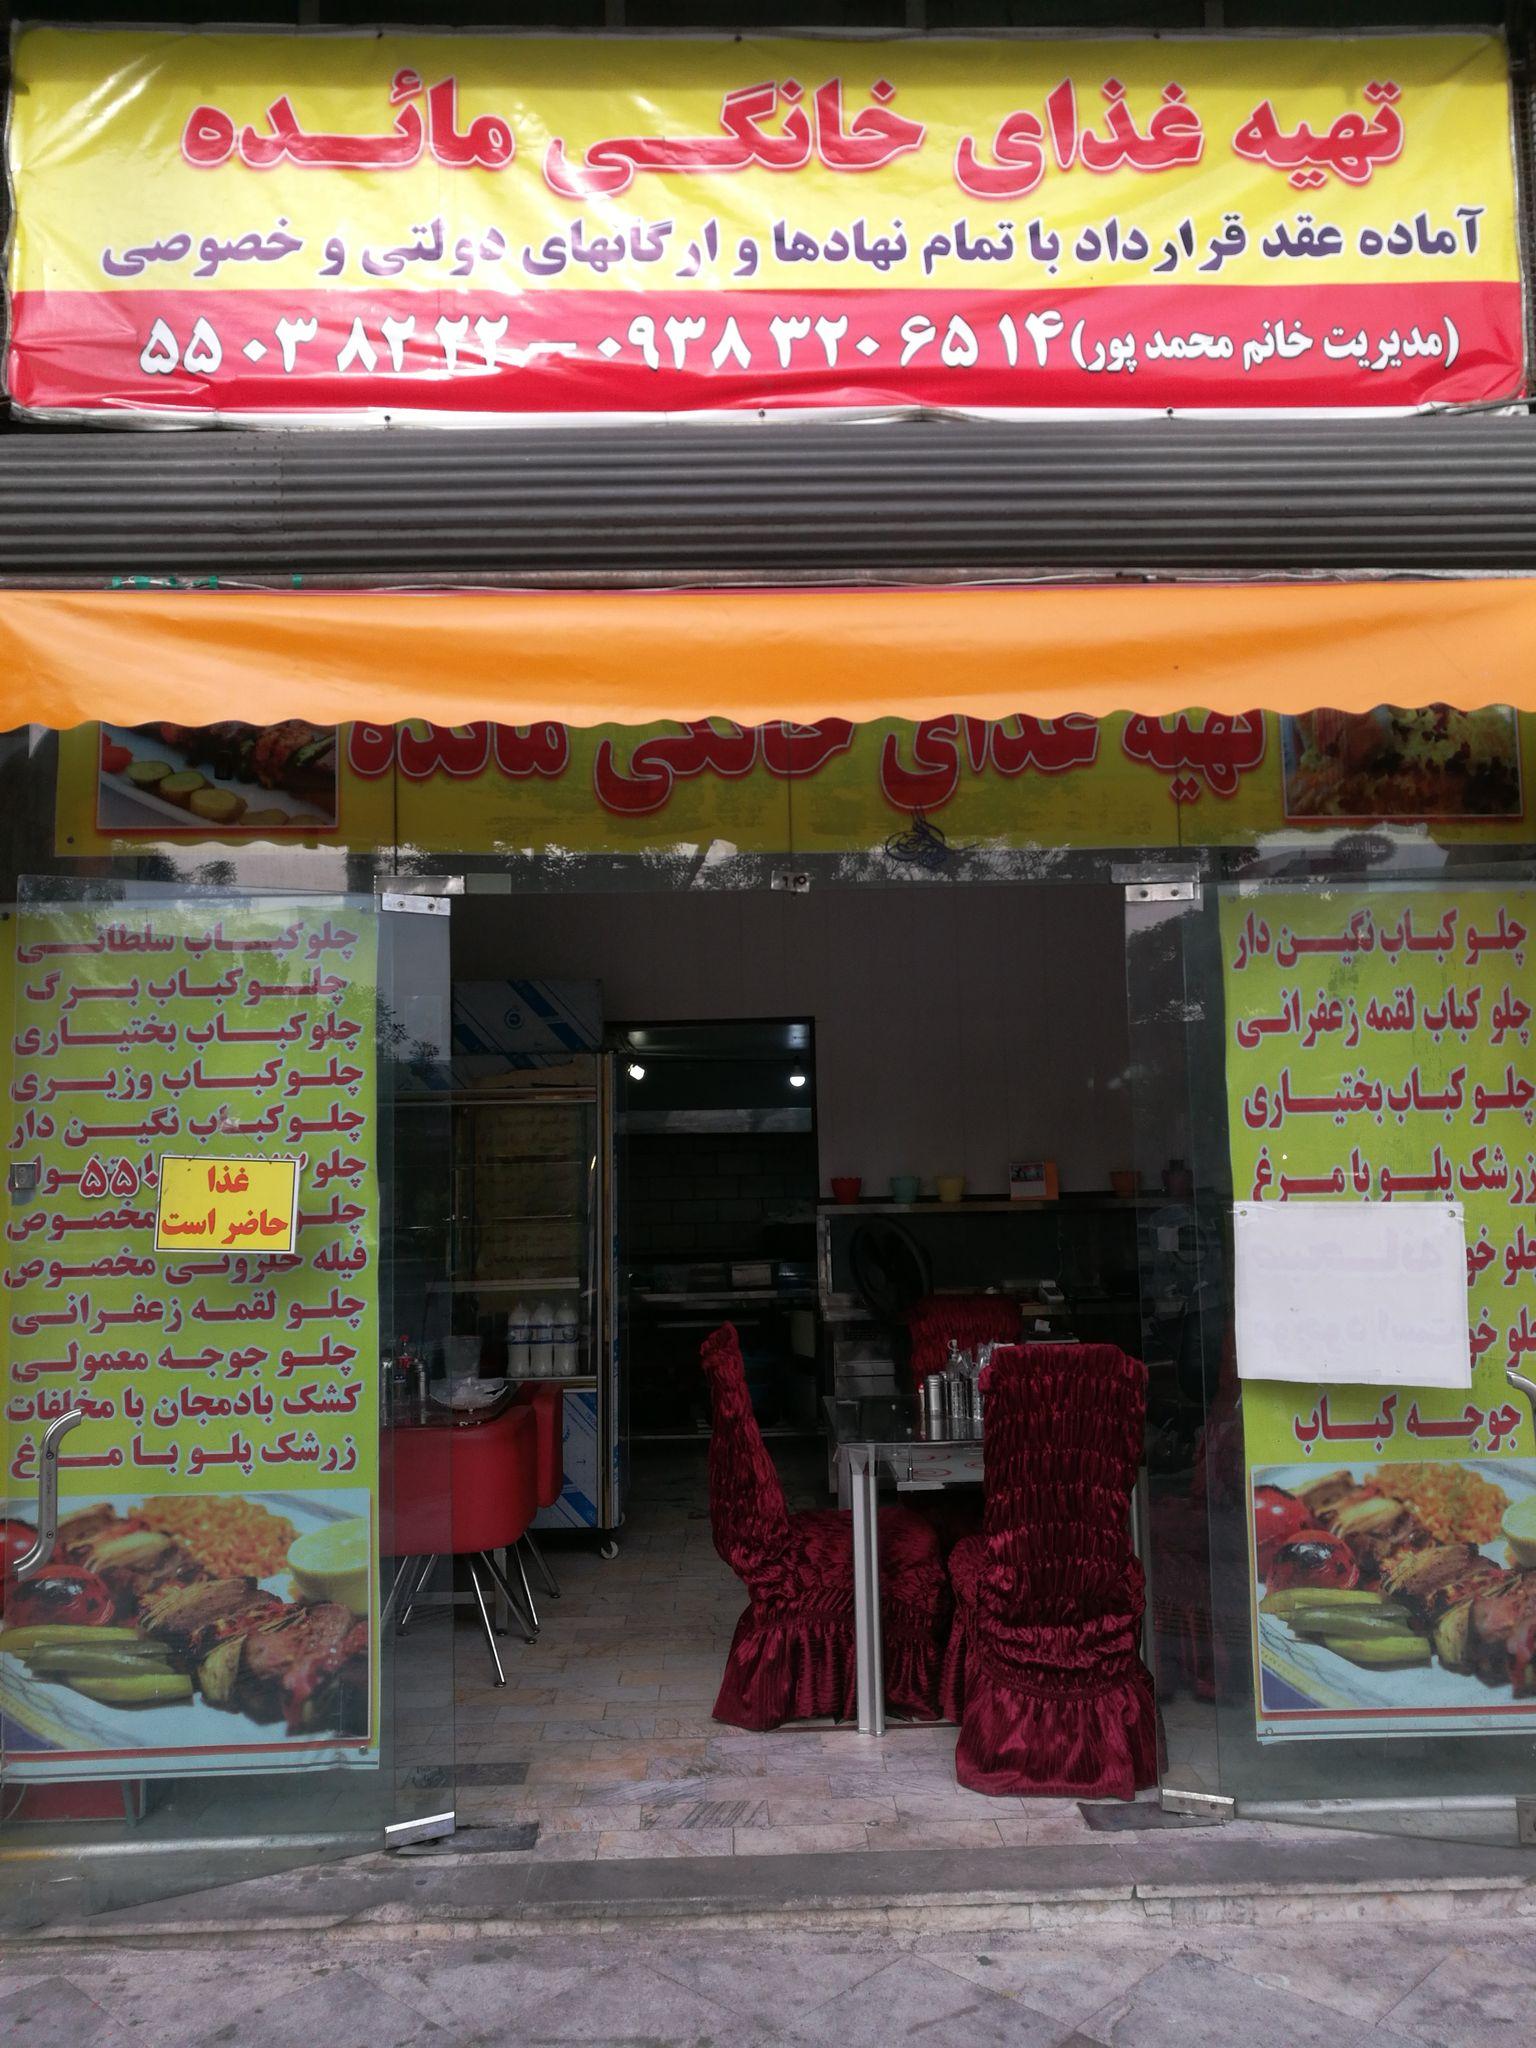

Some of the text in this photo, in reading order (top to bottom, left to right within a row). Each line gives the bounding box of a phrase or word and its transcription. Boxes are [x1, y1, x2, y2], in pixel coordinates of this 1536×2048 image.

[181, 67, 1405, 200] تهیه غذای خانگی مائده
[102, 217, 304, 277] خصوصی
[362, 218, 504, 277] دولتی
[773, 219, 908, 265] نهادها
[922, 219, 1014, 277] تمام
[1028, 220, 1060, 275] با
[1261, 214, 1344, 259] عقد
[1360, 206, 1483, 259] آماده
[318, 241, 346, 276] و
[735, 238, 758, 276] و
[1145, 323, 1236, 365] محمد
[1242, 320, 1313, 371] خانم
[17, 920, 358, 963] چلو کباب سلطانی
[1233, 907, 1526, 969] چلو کباب نگین دار
[26, 968, 347, 1007] چلو کباب برگ
[14, 1011, 362, 1055] چلو کباب بختیاری
[1237, 986, 1531, 1048] چلو کباب لقمه زعفرانی
[11, 1058, 364, 1101] چلو کباب وزیری
[1244, 1065, 1535, 1128] چلو کباب بختیاری
[8, 1104, 366, 1149] چلو کباب نگین دار
[208, 1165, 249, 1193] غذا
[312, 1148, 367, 1189] چلو
[1252, 1146, 1536, 1203] زرشک پلو با مرغ
[7, 1194, 366, 1242] چل مخصوص
[162, 1208, 288, 1244] حاضر است
[3, 1247, 155, 1289] مخصوص
[313, 1240, 366, 1278] فیله
[11, 1288, 366, 1335] چلو لقمه زعفرانی
[11, 1337, 356, 1381] چلو جوجه معمولی
[6, 1382, 362, 1427] کشک بادمجان با مخلفات
[1295, 1395, 1521, 1454] جوجه کباب
[9, 1432, 356, 1479] زرشک پلو با مغ
